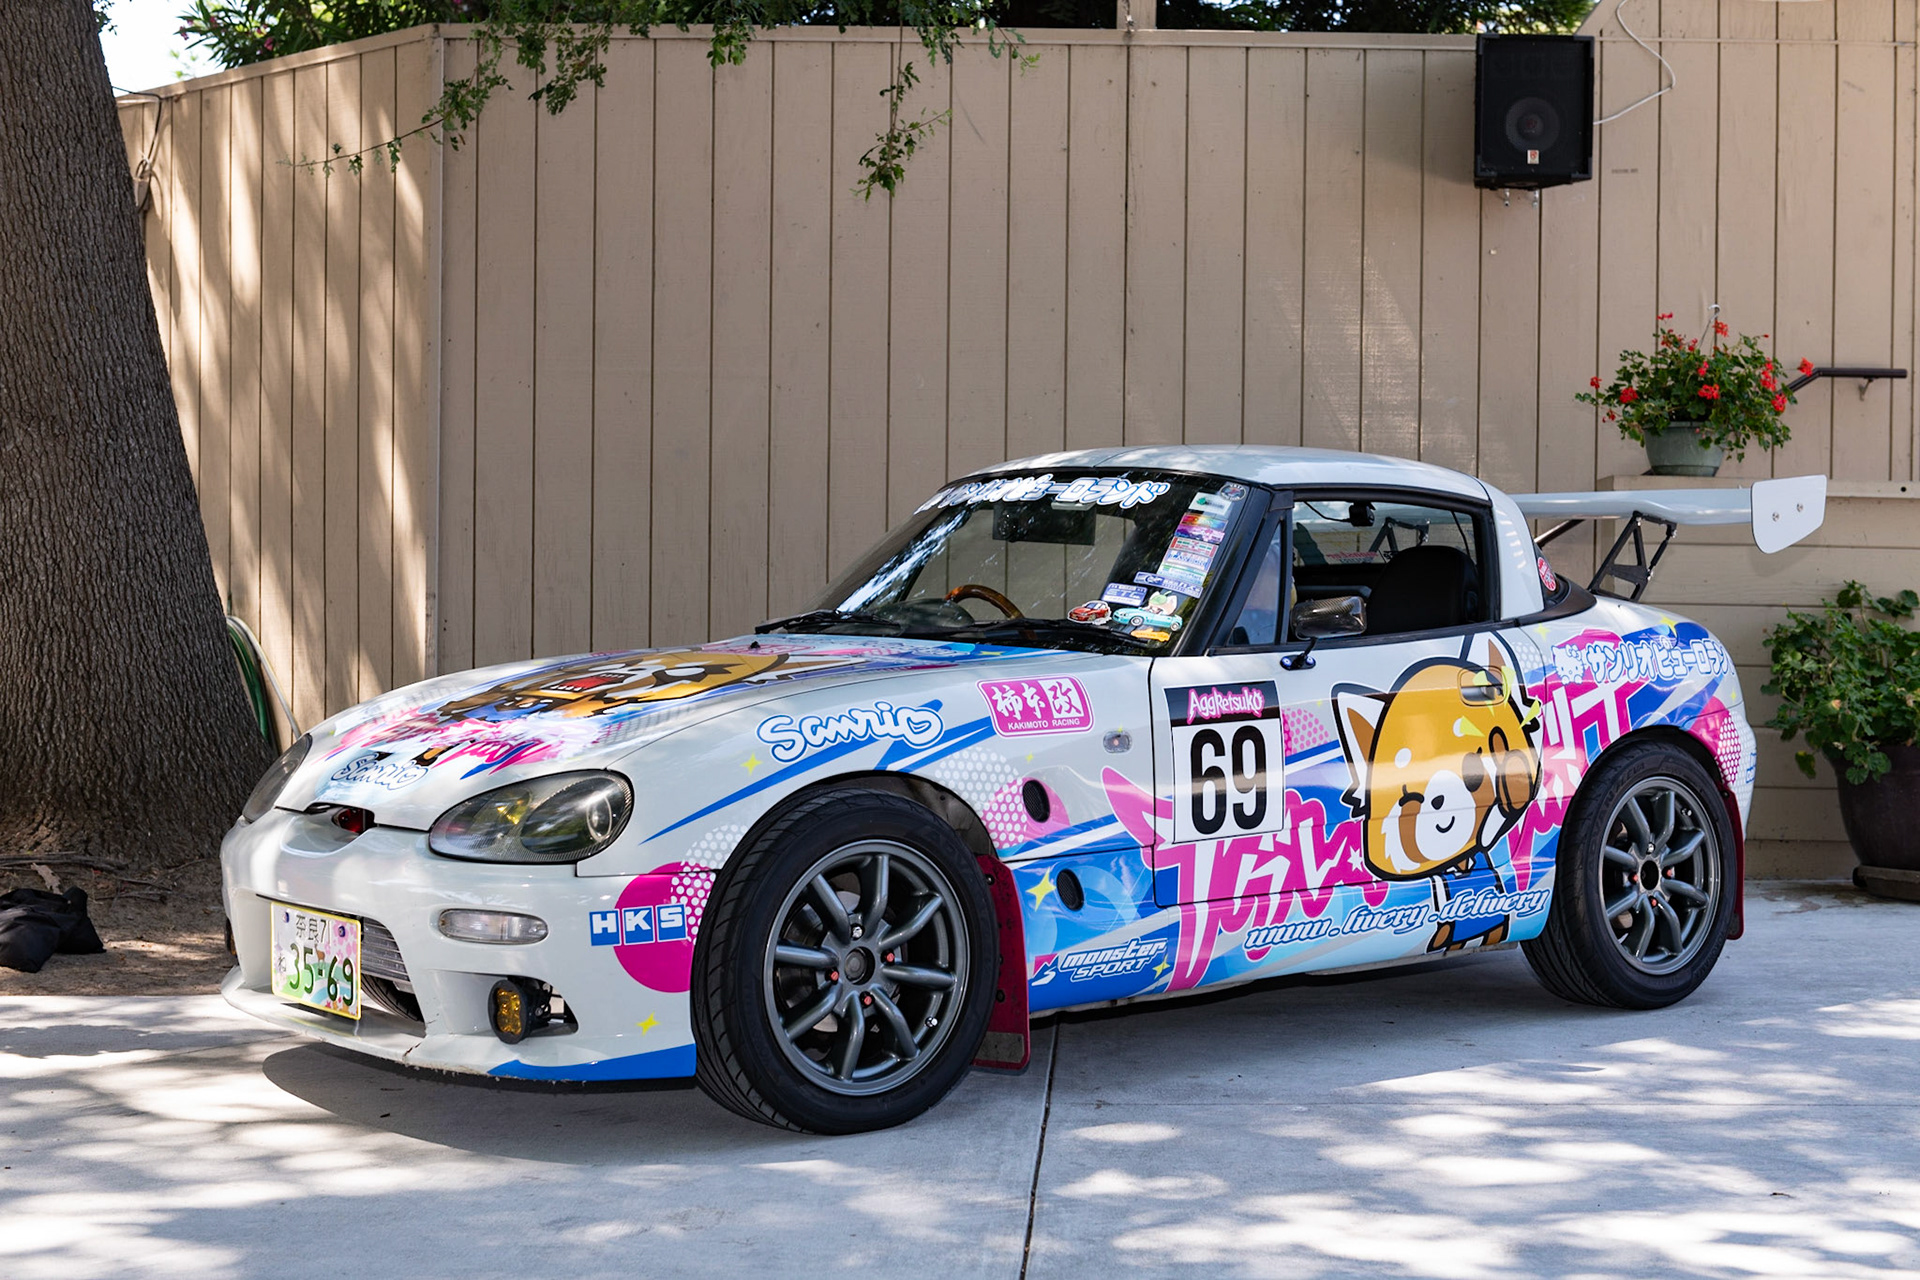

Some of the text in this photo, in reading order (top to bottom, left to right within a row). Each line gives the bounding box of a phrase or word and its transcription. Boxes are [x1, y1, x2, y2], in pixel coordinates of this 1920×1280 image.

[1586, 636, 1734, 684] サンリオピューロラン
[757, 701, 943, 763] Sanrio
[1007, 718, 1080, 730] KAKIMOTO RACING
[1191, 725, 1267, 834] 69
[591, 905, 685, 938] HKS
[1245, 888, 1551, 949] www.livery.delivery
[289, 942, 355, 1007] 35-69
[1061, 939, 1167, 969] monster
[1073, 957, 1150, 979] SPORT
